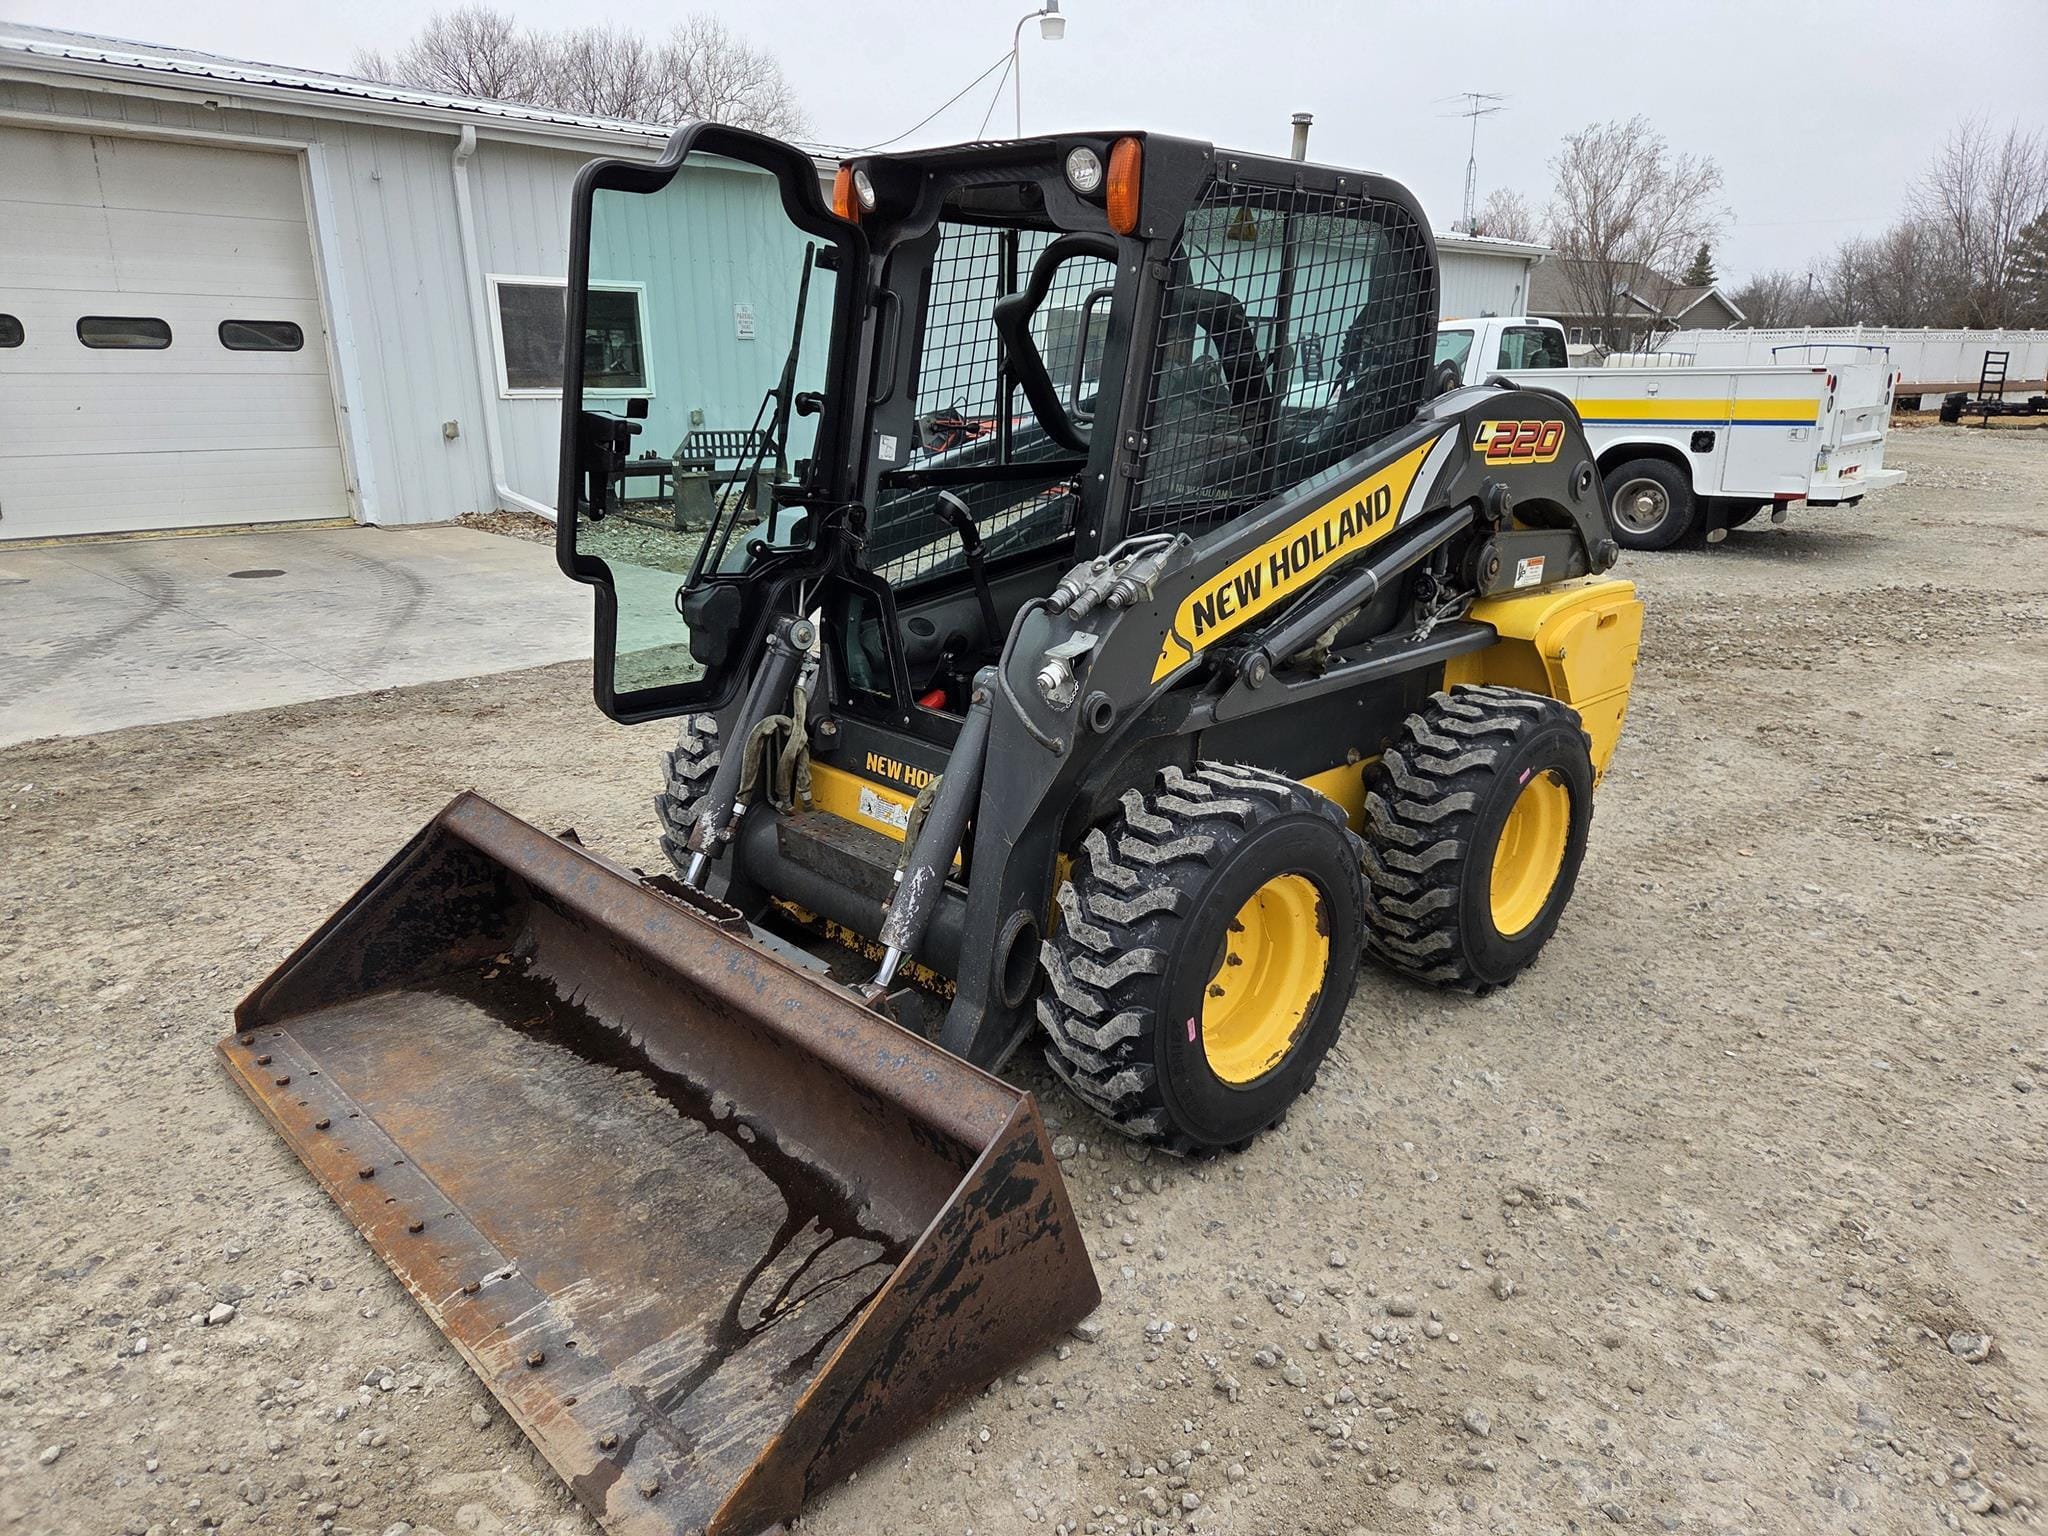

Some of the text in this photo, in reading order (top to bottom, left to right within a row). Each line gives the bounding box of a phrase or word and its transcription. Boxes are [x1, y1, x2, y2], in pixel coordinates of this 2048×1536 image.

[1474, 421, 1565, 464] L220
[1192, 484, 1391, 637] NEW HOLLAND
[866, 752, 902, 781] NEW
